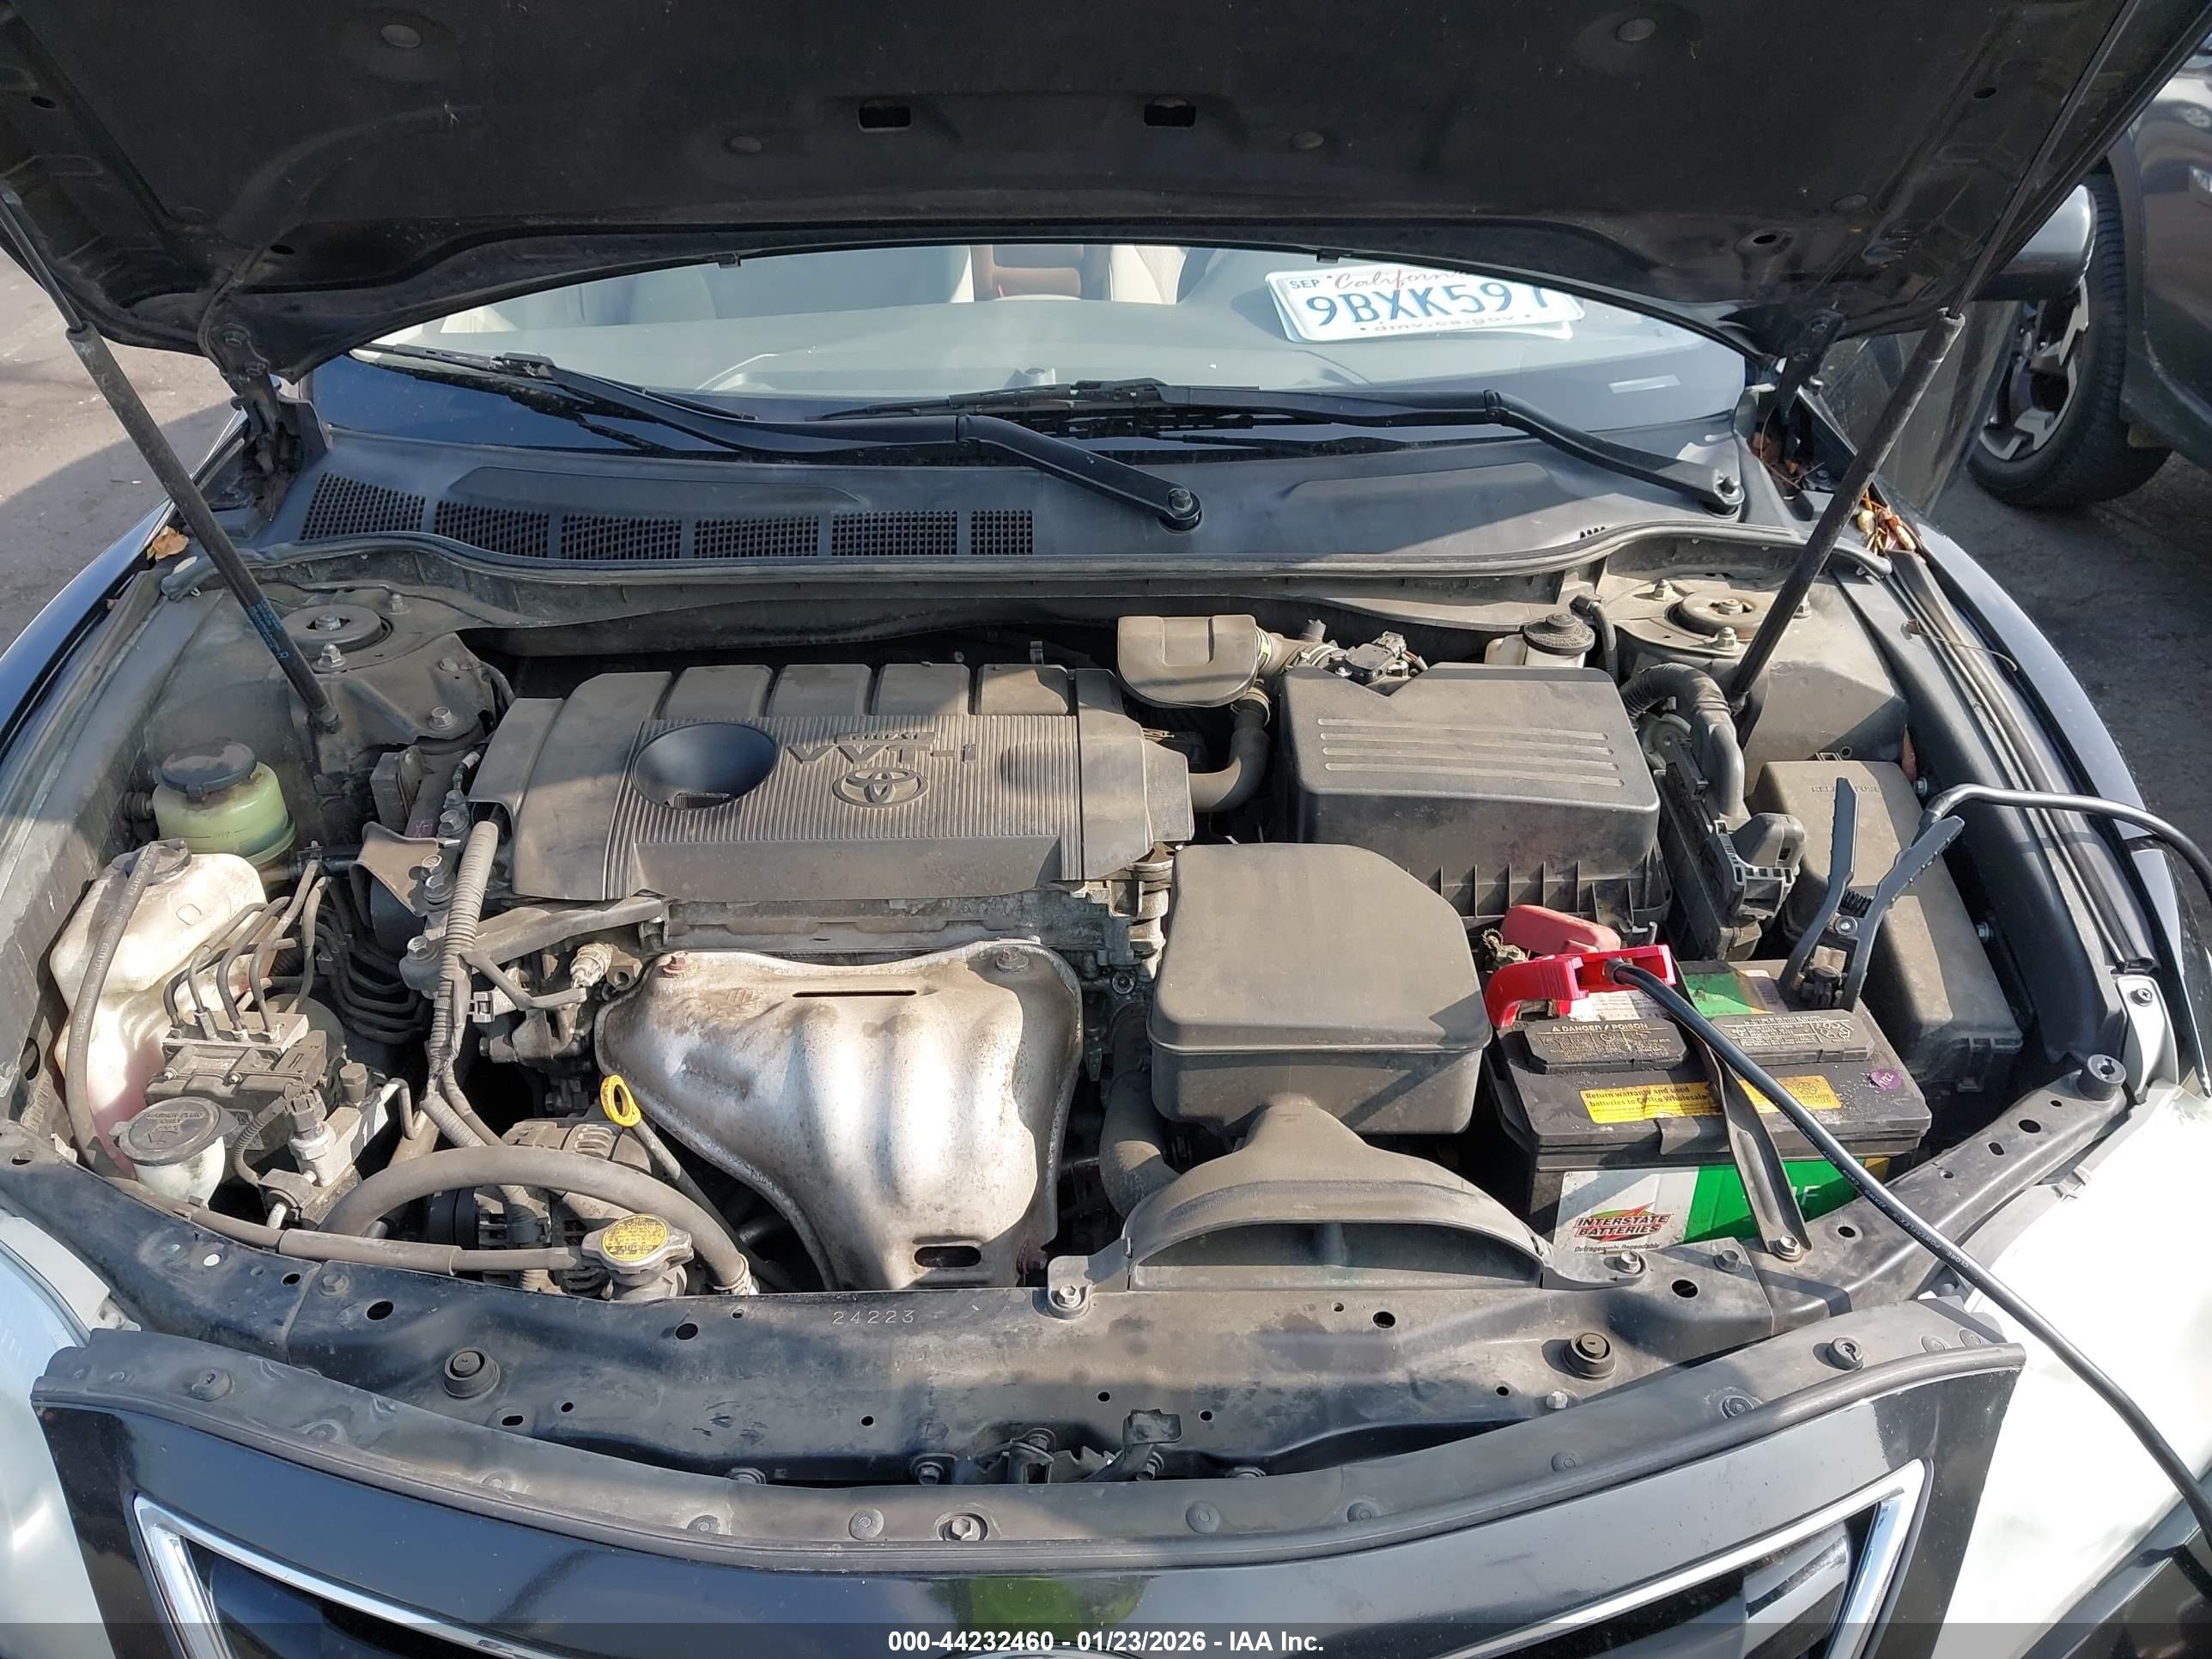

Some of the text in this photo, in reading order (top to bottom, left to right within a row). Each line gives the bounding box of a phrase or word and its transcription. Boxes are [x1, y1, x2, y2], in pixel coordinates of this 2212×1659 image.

[1291, 278, 1320, 290] SEP
[1374, 315, 1514, 331] dmv.ca.gov
[1611, 1023, 1649, 1031] POISON
[1585, 1091, 1614, 1100] Return
[1577, 1214, 1669, 1227] INTERSTATE
[1579, 1224, 1662, 1237] BATTERIES
[832, 1310, 915, 1325] 24223
